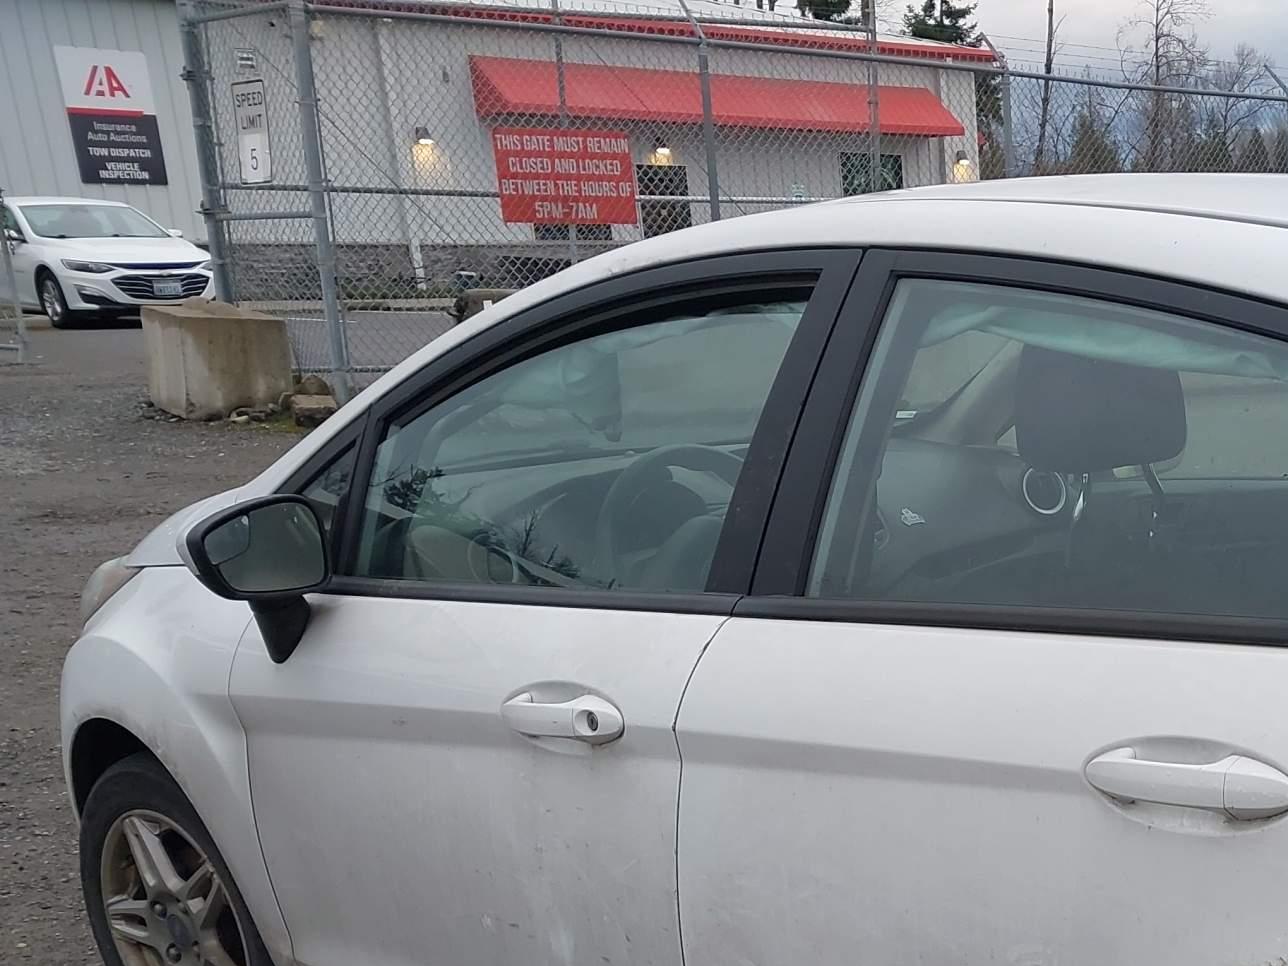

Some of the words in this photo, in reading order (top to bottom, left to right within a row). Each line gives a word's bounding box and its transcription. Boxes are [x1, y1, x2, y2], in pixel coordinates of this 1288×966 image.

[235, 91, 262, 107] SPEED
[93, 121, 137, 132] Insurance
[240, 113, 262, 130] LIMIT
[87, 131, 108, 141] Auto
[110, 132, 147, 143] Auctions
[495, 134, 521, 150] THIS
[523, 134, 552, 152] GATE
[554, 137, 584, 152] MUST
[586, 138, 629, 154] REMAIN
[88, 147, 109, 157] TOW
[110, 148, 152, 158] DISPATCH
[250, 148, 258, 170] 5
[105, 162, 140, 171] VEHICLE
[508, 157, 552, 173] CLOSED
[554, 159, 577, 174] AND
[580, 160, 620, 175] LOCKED
[99, 170, 149, 180] INSPECTION
[501, 179, 555, 195] BETWEEN
[556, 180, 579, 196] THE
[581, 182, 617, 197] HOURS
[619, 182, 633, 197] OF
[535, 201, 598, 220] 5PM-7AM
